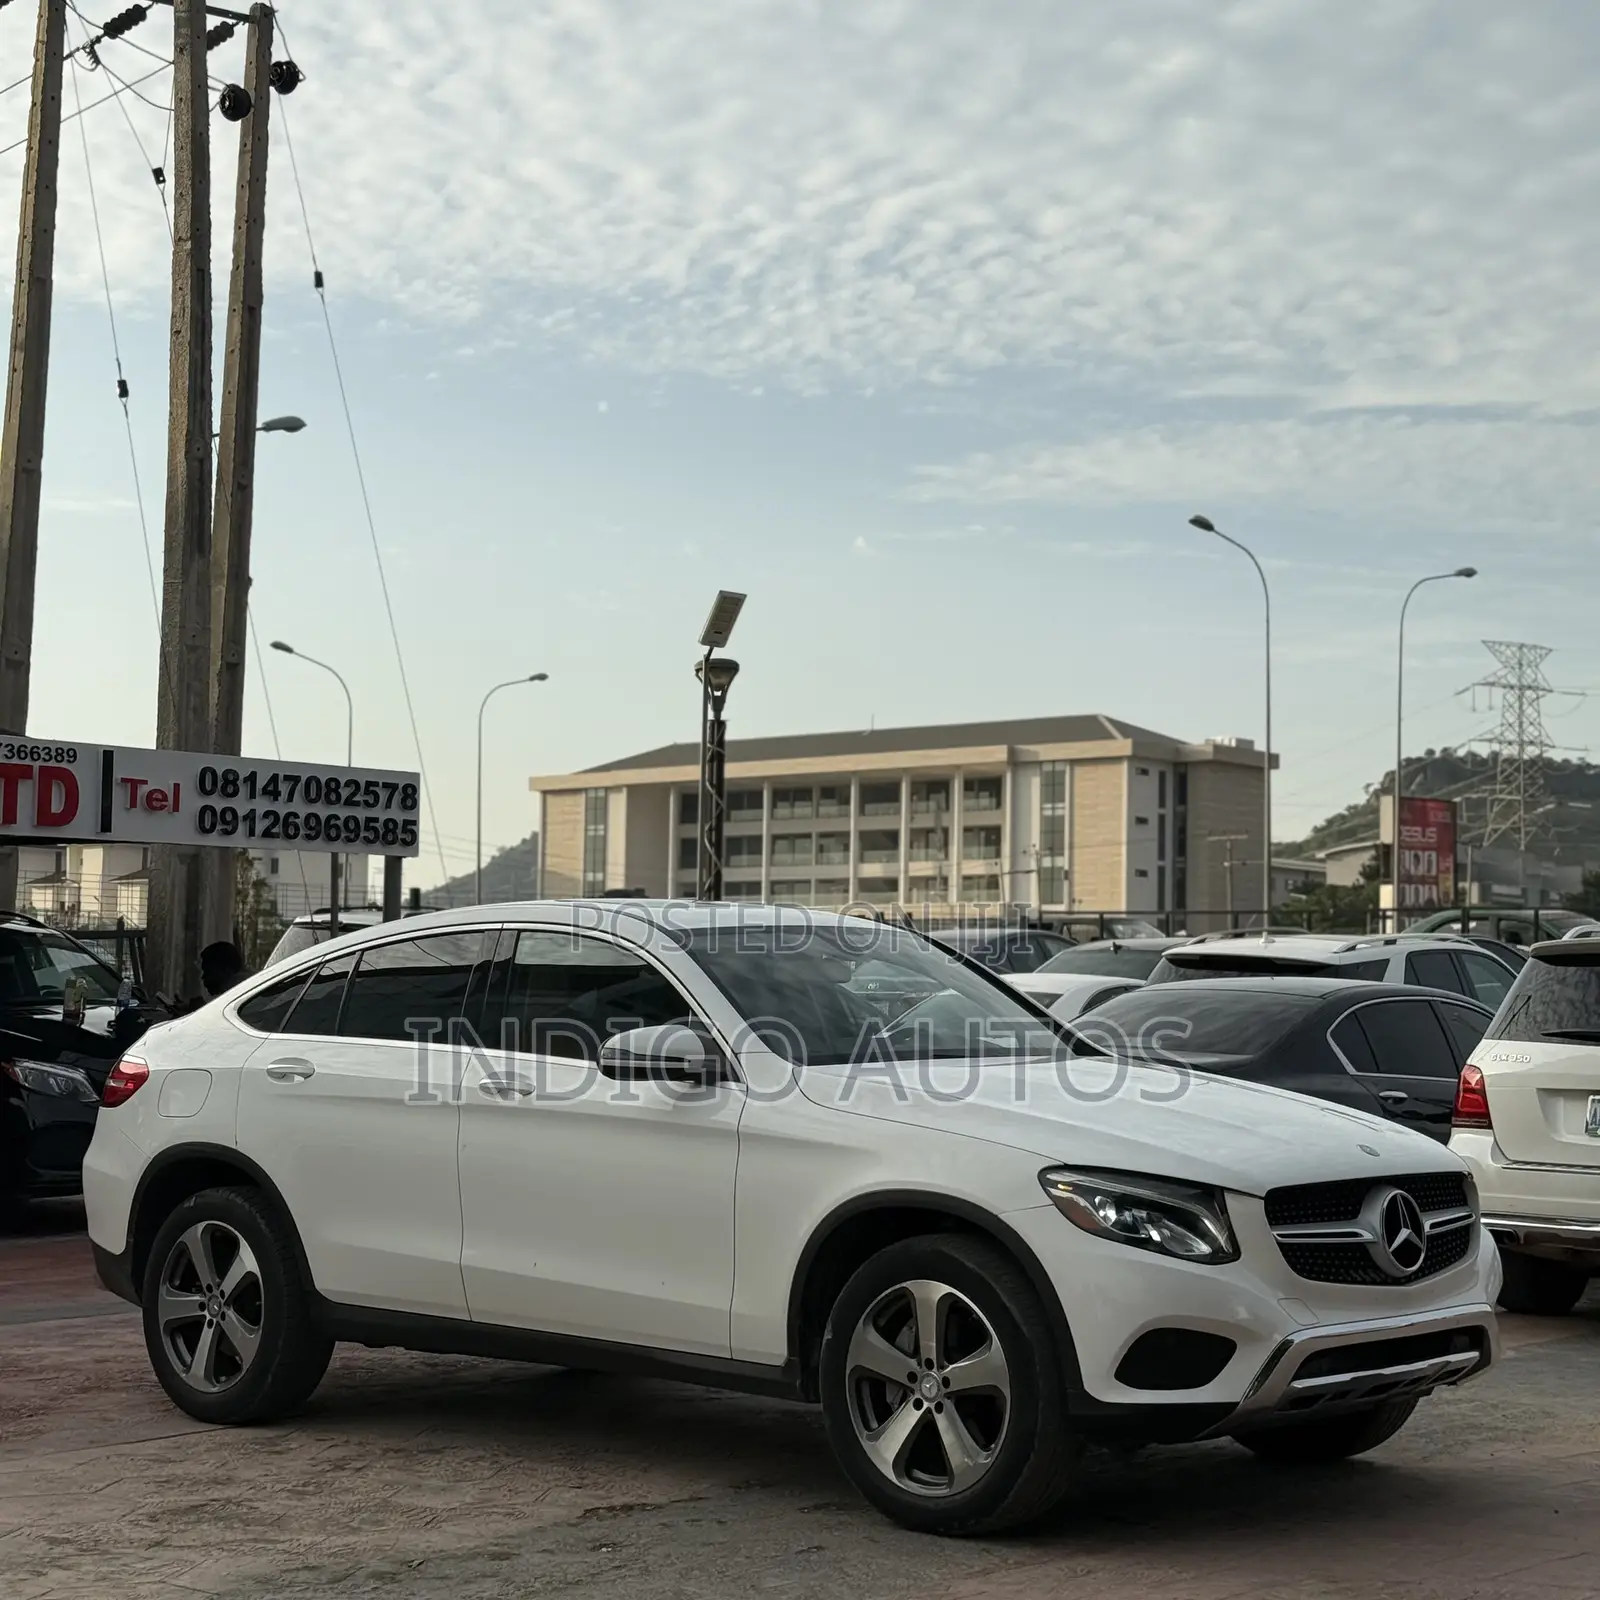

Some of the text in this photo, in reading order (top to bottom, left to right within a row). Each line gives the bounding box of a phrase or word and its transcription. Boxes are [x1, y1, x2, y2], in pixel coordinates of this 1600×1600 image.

[0, 743, 78, 763] 366389
[120, 776, 181, 813] Tel
[198, 766, 418, 811] 08147082578
[198, 804, 418, 847] 09126969585
[1490, 1053, 1531, 1064] GLK 350
